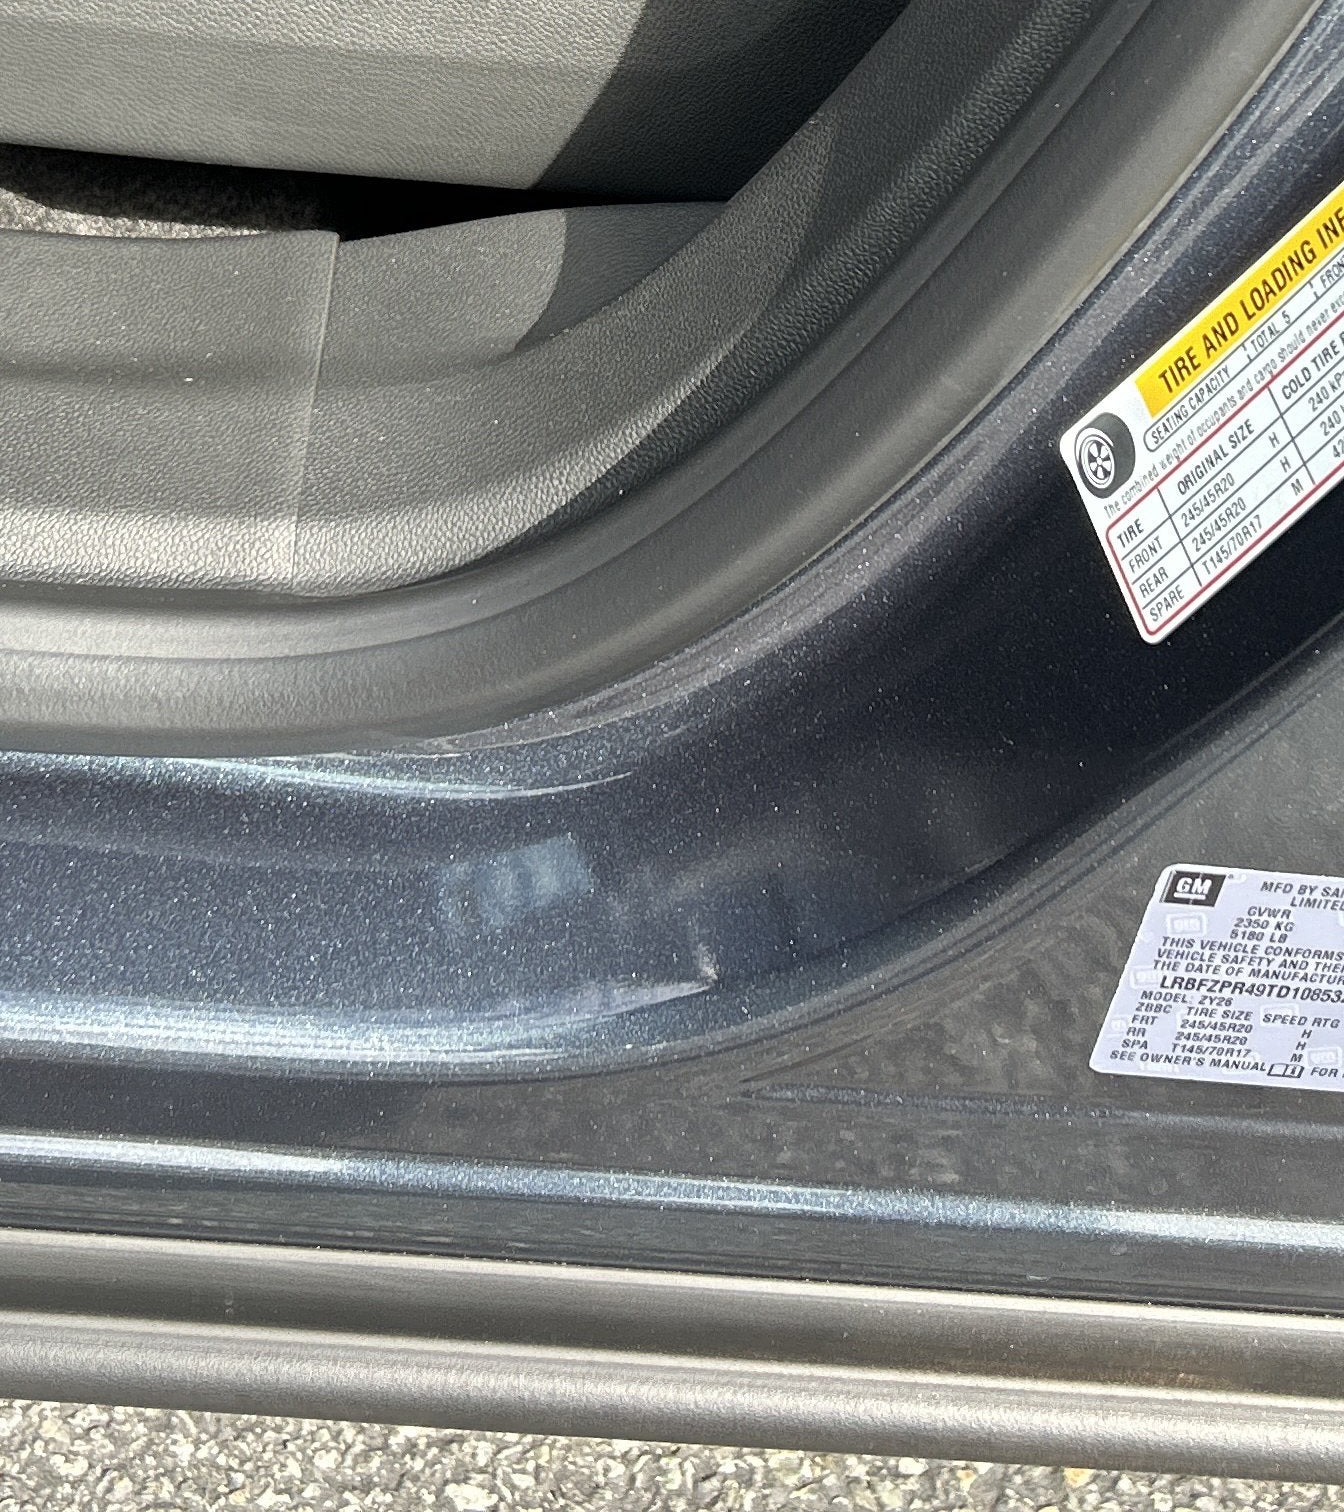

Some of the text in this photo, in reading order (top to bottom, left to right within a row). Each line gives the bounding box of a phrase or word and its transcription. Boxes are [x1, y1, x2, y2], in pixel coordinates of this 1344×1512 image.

[1158, 346, 1202, 394] TIRE
[1202, 311, 1240, 359] AND
[1239, 239, 1317, 321] LOADING
[1250, 310, 1291, 353] TOTAL 5
[1281, 366, 1312, 400] COLD
[1310, 340, 1341, 372] TIRE
[1151, 365, 1230, 445] SEATING CAPACITY
[1307, 385, 1330, 412] 240
[1103, 500, 1121, 519] The
[1121, 463, 1160, 505] combined
[1159, 438, 1188, 470] weight
[1186, 428, 1197, 446] of
[1196, 395, 1238, 438] occupants
[1236, 377, 1254, 401] and
[1253, 358, 1278, 385] cargo
[1277, 329, 1306, 363] should
[1305, 308, 1329, 337] never
[1319, 410, 1342, 437] 240
[1268, 431, 1280, 448] H
[1177, 418, 1255, 496] ORIGINAL SIZE
[1279, 456, 1292, 473] H
[1290, 478, 1304, 496] M
[1181, 472, 1235, 528] 245/45R20
[1116, 518, 1144, 548] TIRE
[1191, 496, 1247, 553] 245/45R20
[1201, 514, 1262, 575] T145/70R17
[1128, 535, 1163, 573] FRONT
[1139, 566, 1169, 599] REAR
[1149, 584, 1185, 622] SPARE
[1175, 877, 1213, 897] GM
[1260, 881, 1294, 894] MFD
[1297, 884, 1319, 896] BY
[1247, 905, 1292, 920] GVWR
[1233, 917, 1295, 932] 2350 KG
[1269, 932, 1288, 944] LB
[1162, 935, 1196, 949] THIS
[1200, 939, 1261, 955] VEHICLE
[1264, 945, 1344, 962] CONFORMS
[1153, 959, 1181, 972] THE
[1184, 962, 1222, 975] DATE
[1225, 965, 1244, 977] OF
[1157, 947, 1217, 963] VEHICLE
[1220, 953, 1276, 968] SAFETY
[1277, 958, 1309, 971] AND
[1197, 994, 1234, 1007] ZY26
[1131, 1014, 1158, 1026] FRT
[1186, 1005, 1254, 1021] TIRE SIZE
[1262, 1013, 1341, 1029] SPEED RTG
[1126, 1026, 1147, 1038] RR
[1180, 1018, 1253, 1034] 245/45R20
[1301, 1029, 1313, 1039] H
[1121, 1038, 1148, 1050] SPA
[1174, 1031, 1248, 1046] 245/45R20
[1295, 1041, 1307, 1051] H
[1171, 1042, 1252, 1058] T145/70R17
[1289, 1053, 1304, 1063] M
[1109, 1049, 1267, 1072] SEE OWNER'S MANUAL
[1310, 1066, 1339, 1078] FOR
